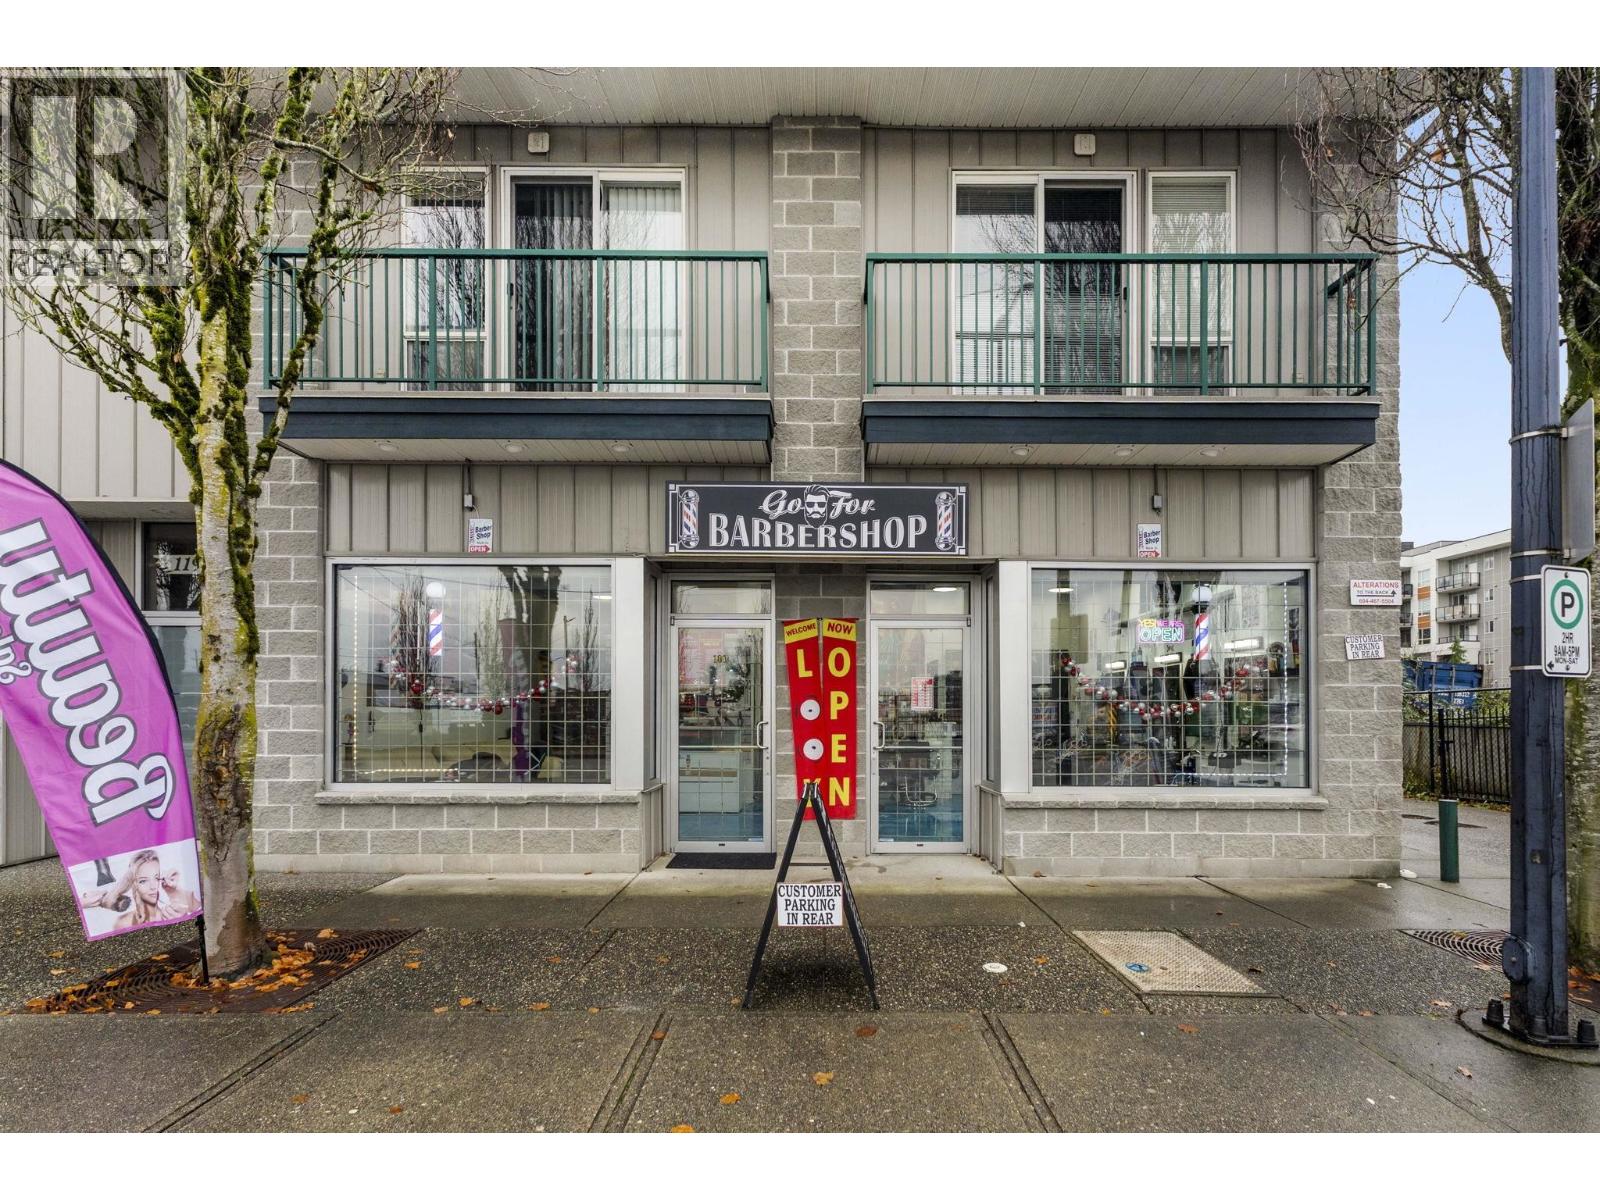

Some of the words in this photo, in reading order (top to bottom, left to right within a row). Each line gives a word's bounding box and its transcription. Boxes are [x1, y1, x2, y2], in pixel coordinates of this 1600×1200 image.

[758, 489, 805, 519] Go
[828, 490, 876, 519] For
[708, 512, 928, 549] BARBERSHOP
[1353, 581, 1399, 589] ALTERATIONS
[1561, 591, 1575, 618] P
[785, 622, 817, 636] WELCOME
[827, 621, 853, 635] NOW
[1140, 627, 1183, 642] OPEN
[1345, 635, 1383, 643] CUSTOMER
[1562, 632, 1574, 644] 2HR
[1350, 643, 1380, 651] PARKING
[1553, 645, 1580, 658] 9AM-5PM
[1352, 651, 1360, 659] IN
[1361, 650, 1380, 658] REAR
[1554, 656, 1579, 665] MON-SAT
[828, 647, 851, 807] OPEN
[778, 884, 842, 898] CUSTOMER
[784, 898, 836, 911] PARKING
[786, 912, 798, 925] IN
[802, 912, 834, 925] REAR
